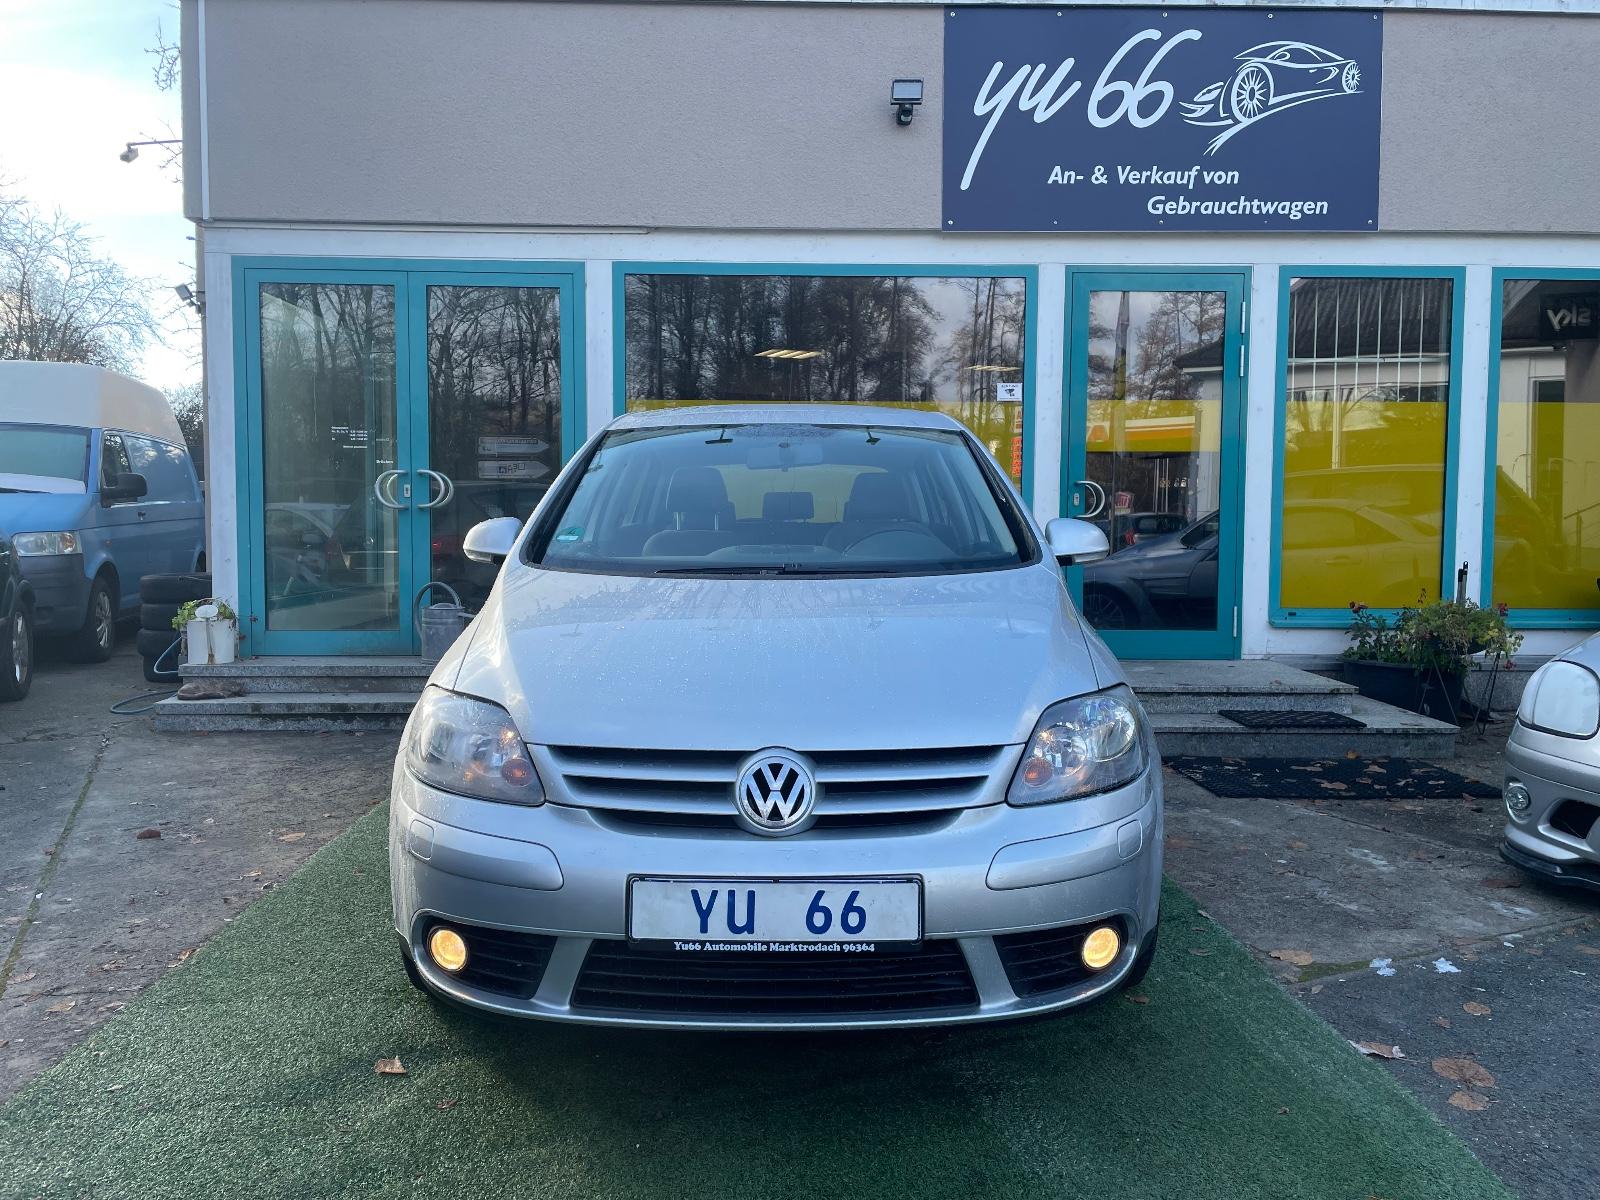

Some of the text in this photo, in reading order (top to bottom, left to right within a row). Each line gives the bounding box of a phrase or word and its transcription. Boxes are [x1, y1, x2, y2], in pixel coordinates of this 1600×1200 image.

[960, 28, 1202, 190] yu 66
[1047, 165, 1240, 189] An- & Verkauf von
[1147, 195, 1329, 220] Gebrauchtwagen
[741, 755, 811, 827] VW
[690, 889, 867, 935] YU 66
[673, 942, 875, 953] Yu66 Automobile Marktrodach 96364
